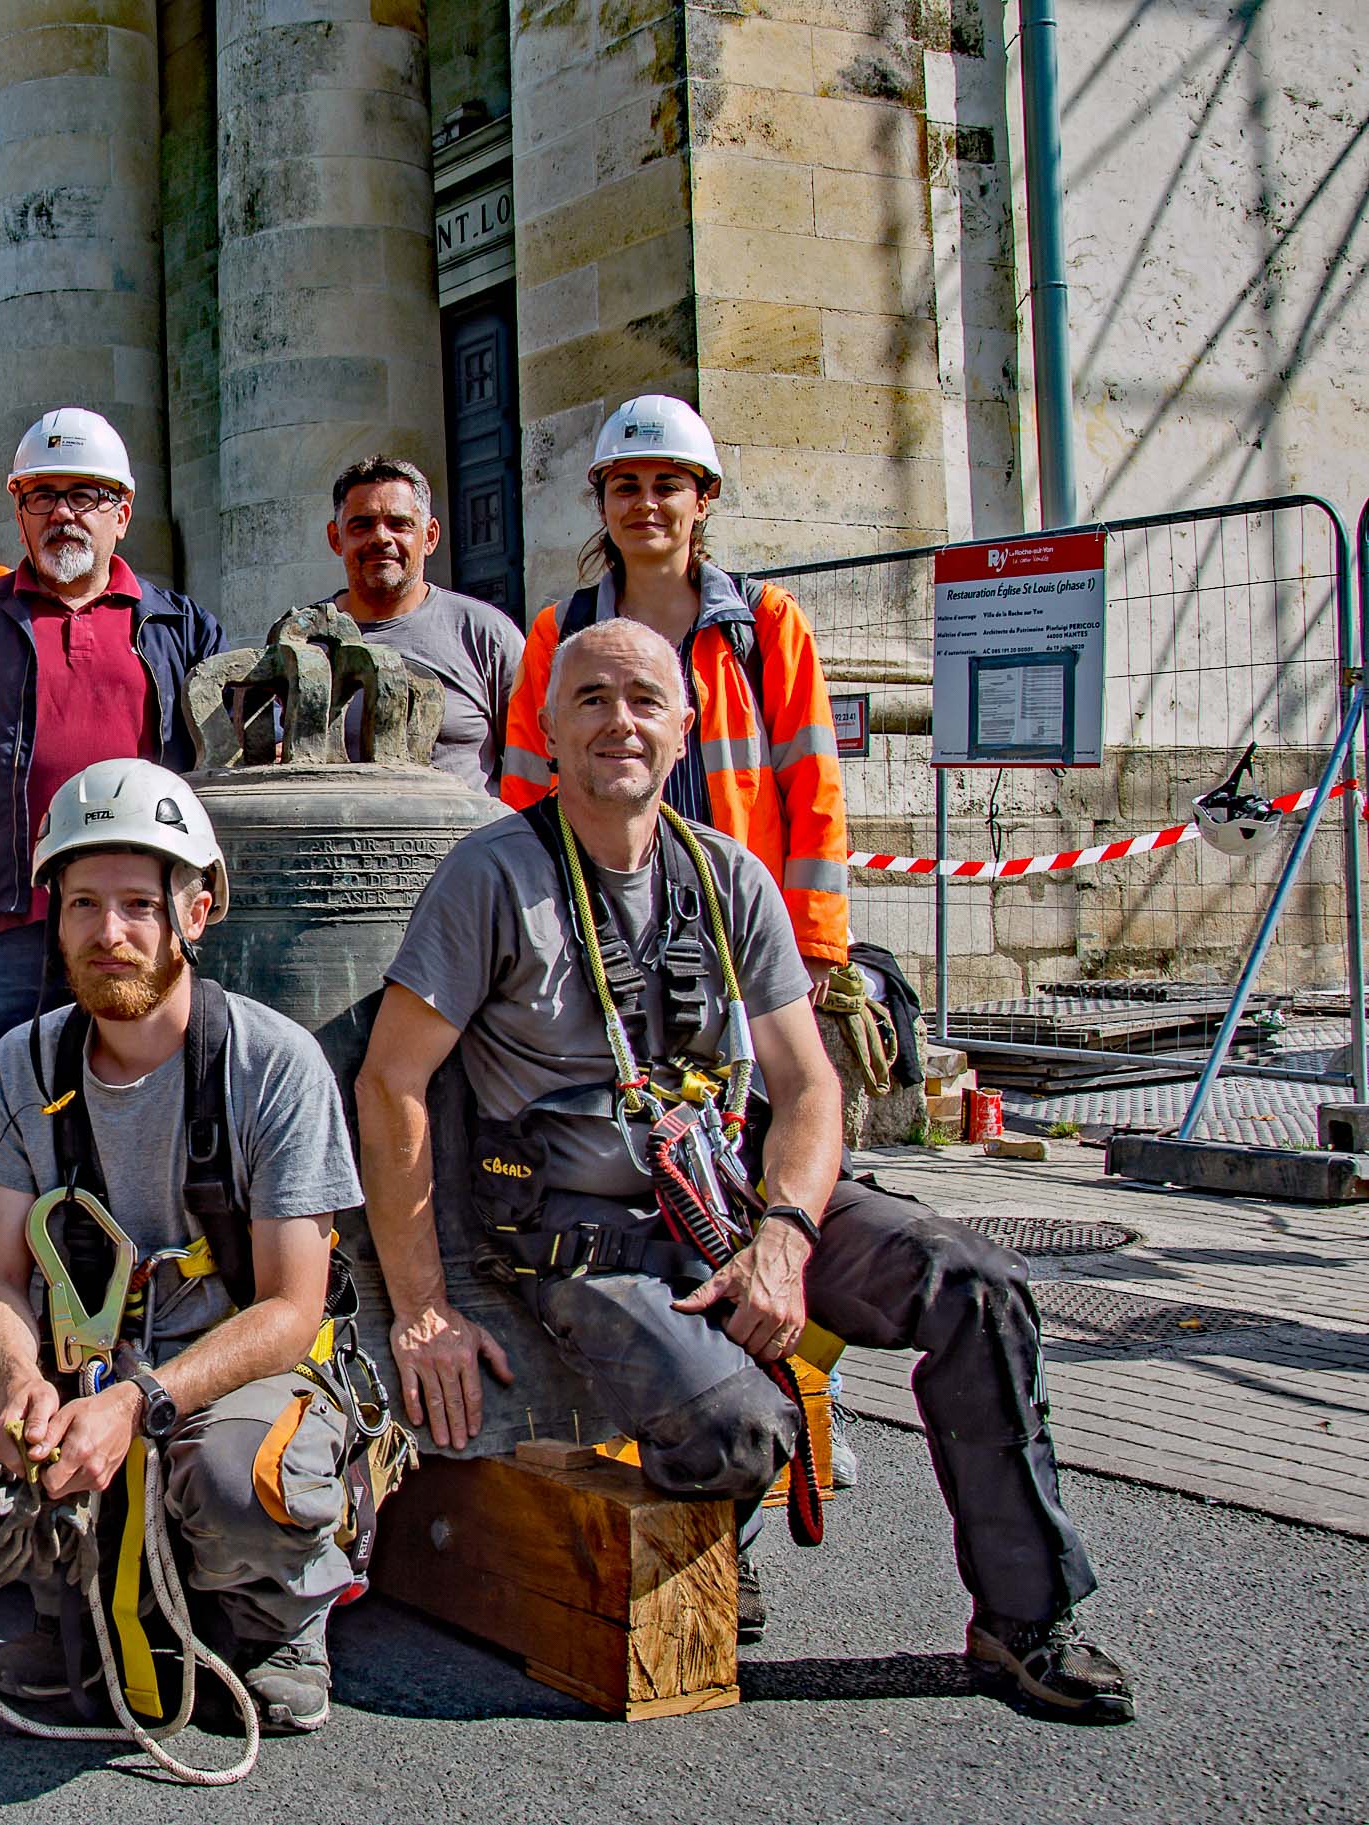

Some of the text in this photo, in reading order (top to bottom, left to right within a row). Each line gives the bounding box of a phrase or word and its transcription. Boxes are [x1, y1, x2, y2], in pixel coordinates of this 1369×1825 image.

[947, 577, 1096, 601] Restauration Église St Louis (phase 1)
[1069, 621, 1100, 630] PERICOLO
[1064, 630, 1088, 638] NANTES
[84, 810, 115, 826] PETZL
[389, 838, 439, 852] LOUIS
[488, 1157, 529, 1178] BEAL
[357, 1529, 371, 1559] PETZL
